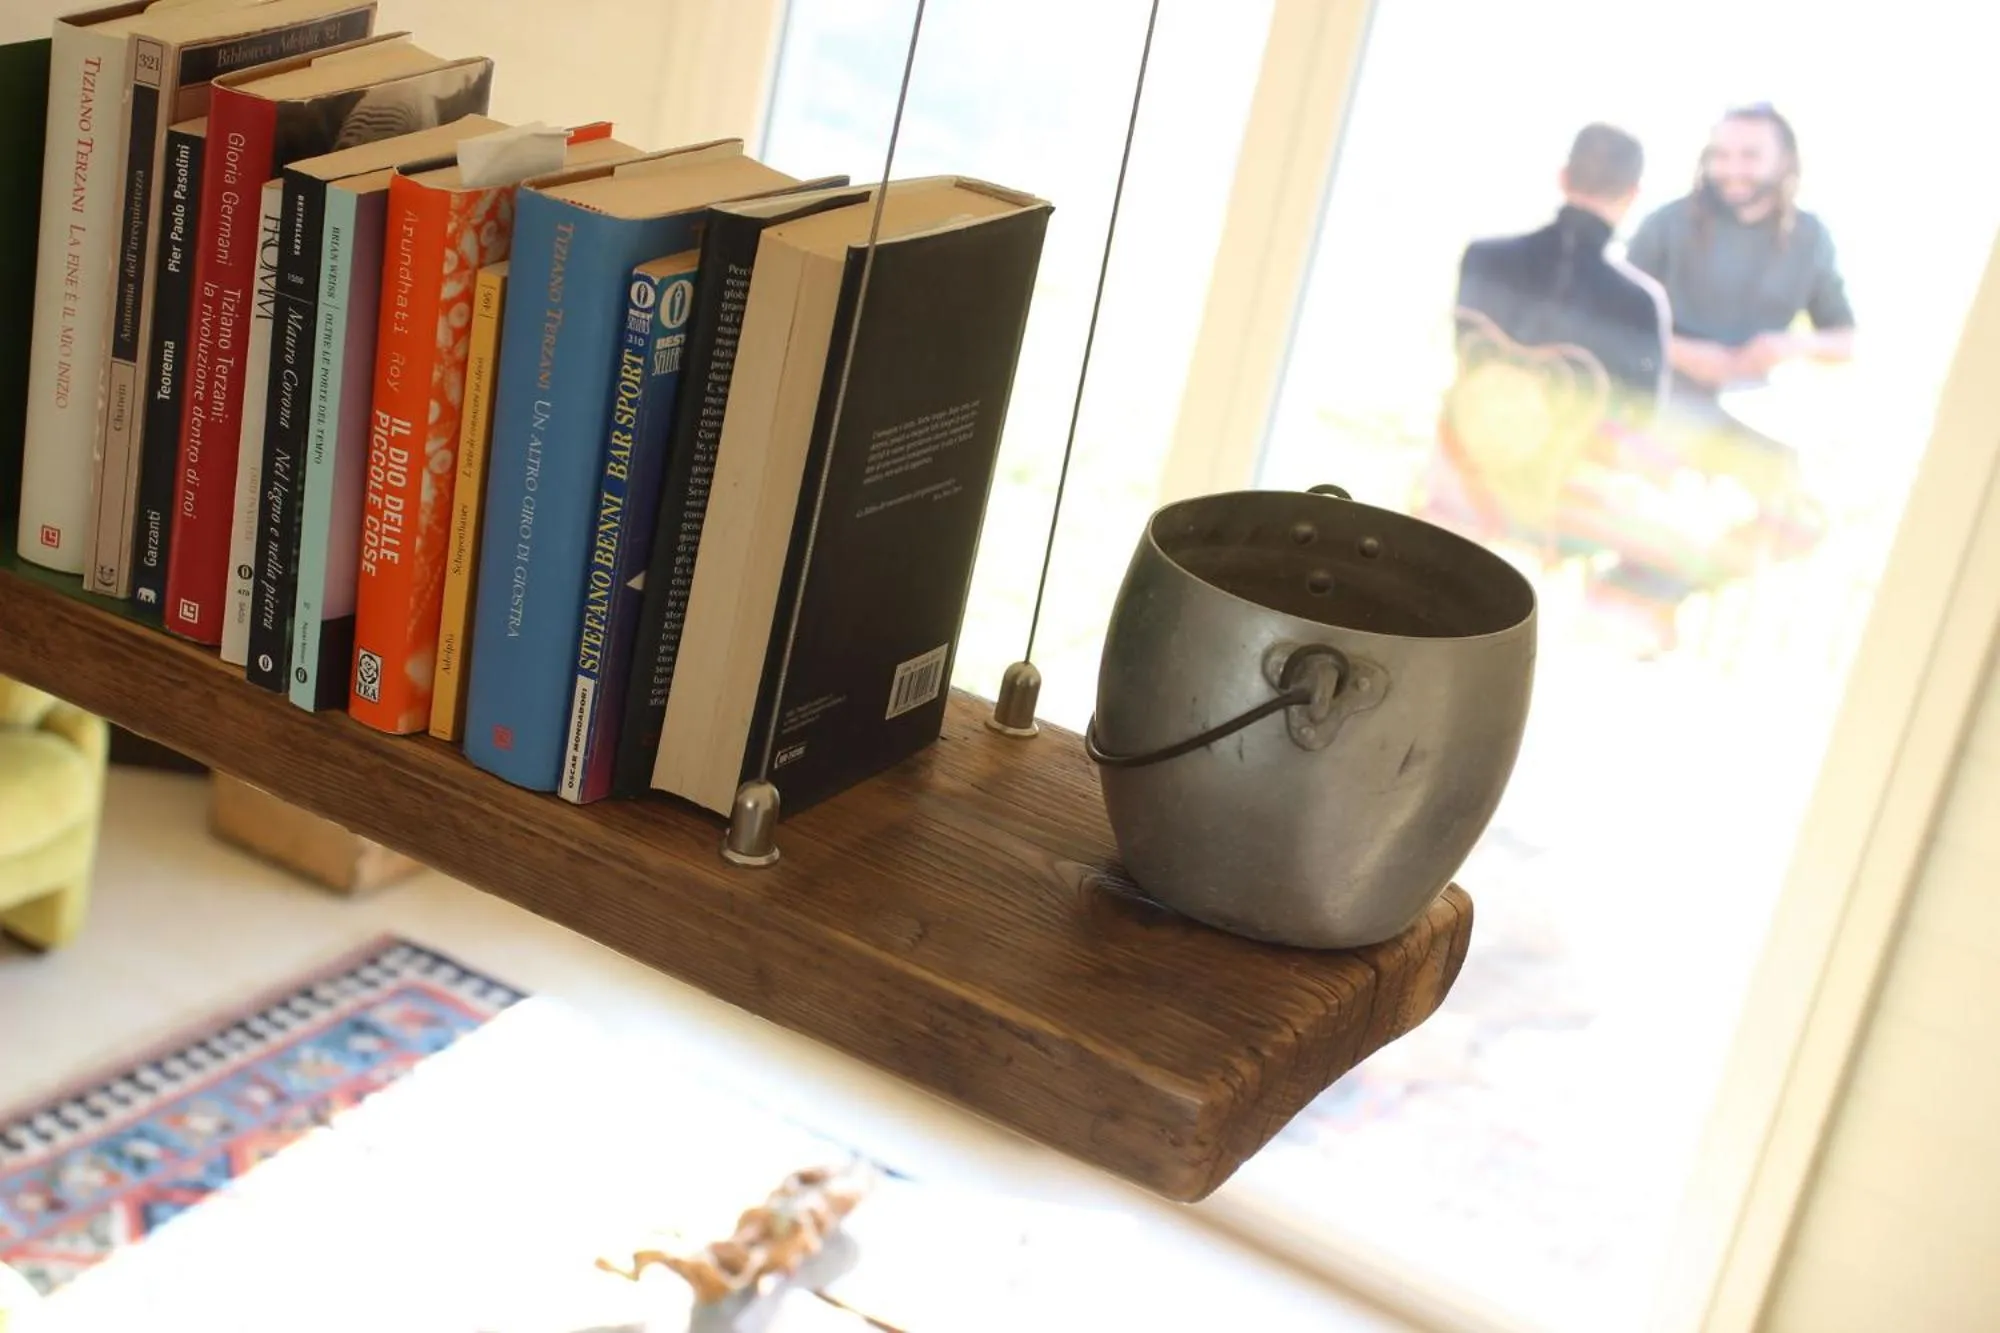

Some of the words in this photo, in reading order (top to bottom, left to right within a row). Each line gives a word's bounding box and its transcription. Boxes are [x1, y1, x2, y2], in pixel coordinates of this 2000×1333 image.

[137, 52, 162, 72] 321
[78, 56, 102, 132] TIZIANO
[71, 137, 94, 214] TERZANI
[173, 143, 191, 201] Pasolini
[224, 132, 246, 185] Gloria
[68, 222, 86, 247] LA
[171, 203, 185, 242] Paolo
[216, 191, 240, 267] Germani
[294, 195, 304, 256] BESTSELLERS
[330, 226, 341, 260] BRIAN
[64, 252, 81, 286] FINE
[168, 244, 181, 273] Pier
[327, 264, 338, 299] WEISS
[393, 210, 420, 335] Arundhati
[547, 222, 575, 304] TIZIANO
[61, 305, 77, 320] IL
[120, 283, 136, 342] Anatomia
[204, 281, 219, 298] la
[58, 325, 75, 358] MIO
[218, 288, 242, 350] Tiziano
[283, 306, 304, 365] Mauro
[322, 312, 333, 350] OLTRE
[157, 340, 176, 401] Teorema
[192, 303, 217, 401] rivoluzione
[321, 350, 331, 365] LE
[536, 308, 563, 390] TERZANI
[54, 360, 72, 410] INIZIO
[114, 383, 127, 432] Chatwin
[211, 356, 235, 424] Terzani:
[280, 369, 299, 429] Corona
[319, 367, 329, 402] PORTE
[614, 348, 645, 430] SPORT
[187, 404, 207, 463] dentro
[317, 404, 326, 426] DEL
[391, 416, 412, 437] IL
[533, 400, 552, 431] UN
[274, 448, 291, 482] Nel
[315, 428, 325, 465] TEMPO
[368, 409, 391, 509] PICCOLE
[386, 446, 409, 488] DIO
[525, 434, 543, 492] ALTRO
[606, 430, 633, 481] BAR
[186, 468, 200, 487] di
[267, 481, 290, 523] legno
[183, 490, 198, 519] noi
[379, 493, 404, 565] DELLE
[519, 495, 536, 539] GIRO
[594, 491, 624, 568] BENNI
[144, 509, 161, 567] Garzanti
[270, 527, 280, 538] e
[362, 515, 380, 577] COSE
[516, 543, 530, 563] DI
[267, 543, 284, 581] nella
[262, 580, 279, 631] pietra
[507, 565, 527, 638] GIOSTRA
[578, 570, 612, 674] STEFANO
[442, 633, 455, 675] Adelphi
[567, 754, 578, 789] OSCAR
[573, 687, 588, 753] MONDADORI
